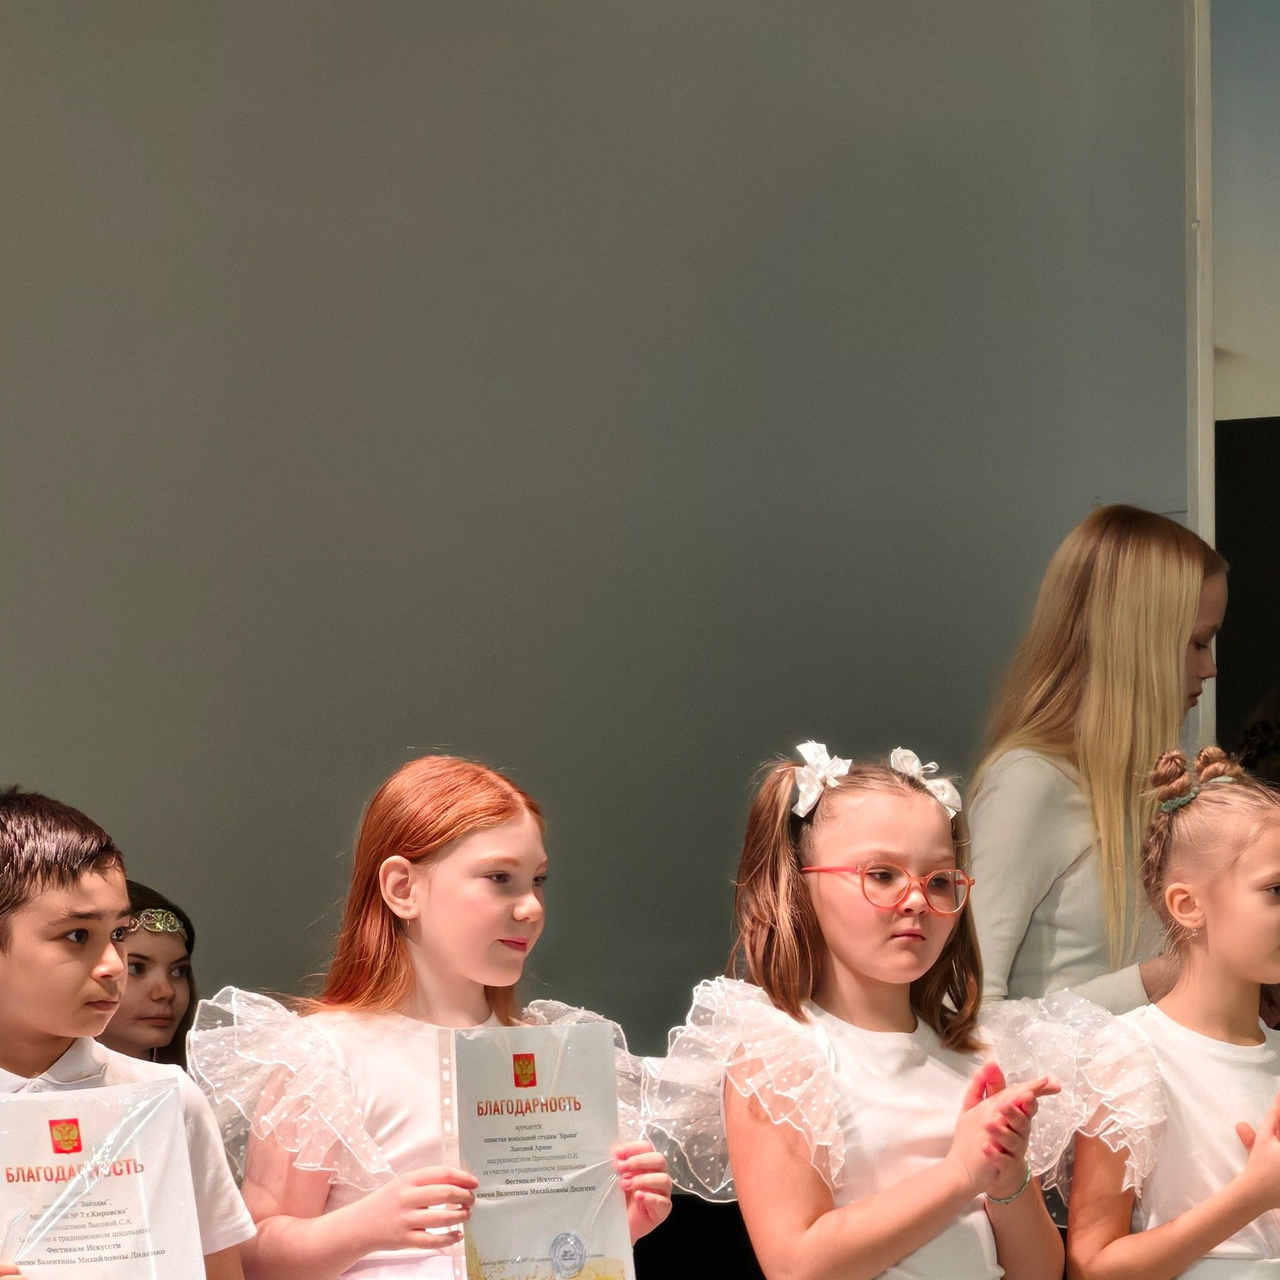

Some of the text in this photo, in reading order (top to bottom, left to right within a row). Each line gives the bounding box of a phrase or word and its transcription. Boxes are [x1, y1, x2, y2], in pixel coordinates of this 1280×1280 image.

[476, 1095, 582, 1117] БЛАГОДАРНОСТЬ
[5, 1158, 145, 1184] БЛАГОДАСТЬ
[530, 1187, 569, 1195] Михайловны
[58, 1232, 111, 1243] традиционном
[46, 1243, 122, 1254] Фестивале Искусств
[37, 1258, 77, 1266] Валентины
[77, 1253, 129, 1264] Михайловны
